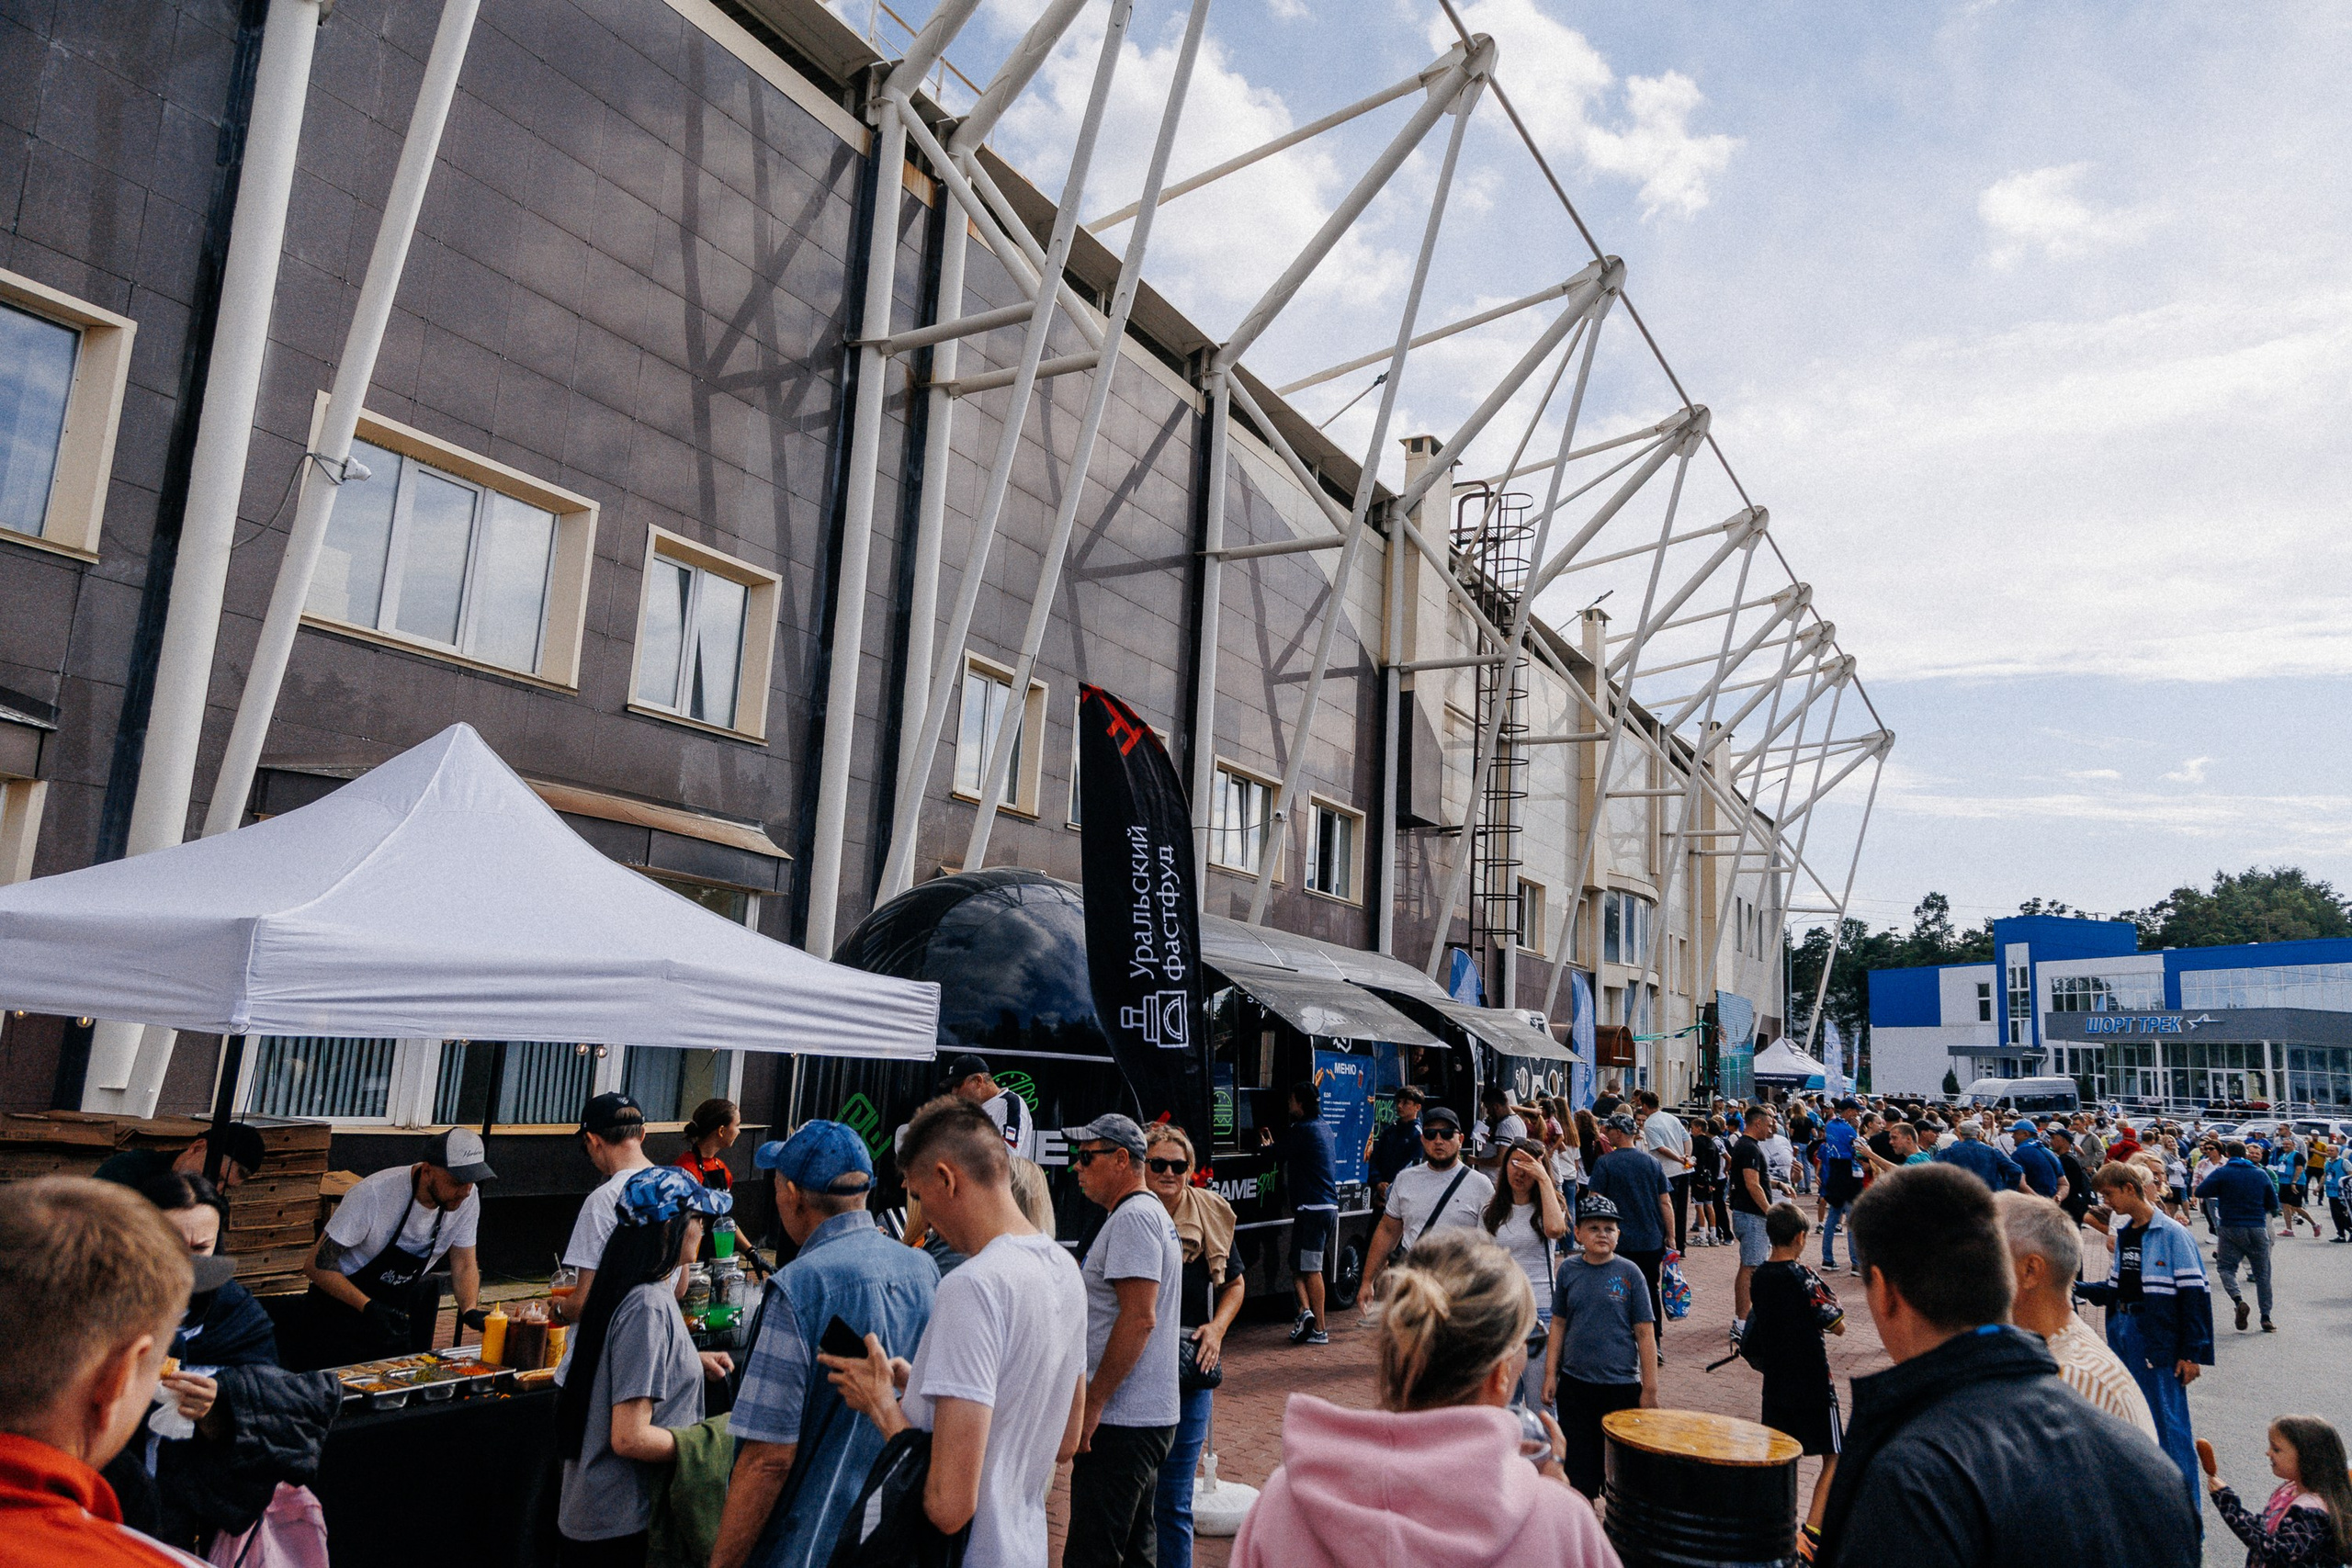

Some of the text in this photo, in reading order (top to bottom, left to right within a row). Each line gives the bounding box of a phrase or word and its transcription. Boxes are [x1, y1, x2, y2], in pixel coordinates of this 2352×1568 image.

[1126, 826, 1159, 980] Уральский
[1156, 845, 1186, 981] фастфуд
[2086, 1016, 2183, 1033] ШОРТ ТРЕК
[1334, 1062, 1357, 1076] МЕНЮ
